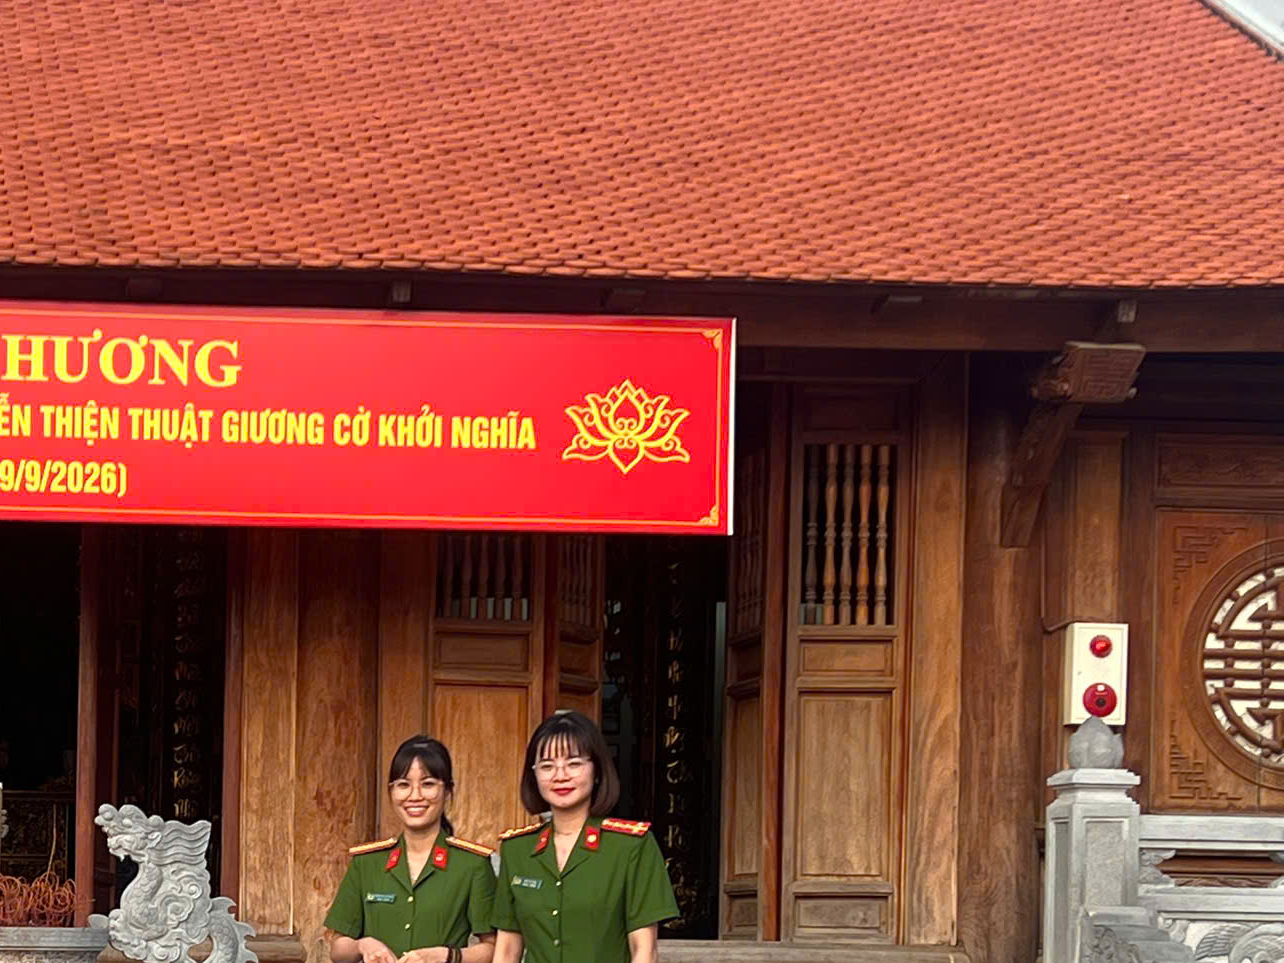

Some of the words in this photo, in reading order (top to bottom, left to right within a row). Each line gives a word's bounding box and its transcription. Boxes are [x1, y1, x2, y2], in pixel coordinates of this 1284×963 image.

[0, 328, 243, 388] HƯƠNG
[39, 399, 120, 446] THIỆN
[127, 402, 214, 449] THUẬT
[221, 407, 325, 445] GIƯƠNG
[333, 405, 372, 447] CỜ
[378, 404, 443, 448] KHỞI
[451, 410, 536, 450] NGHĨA
